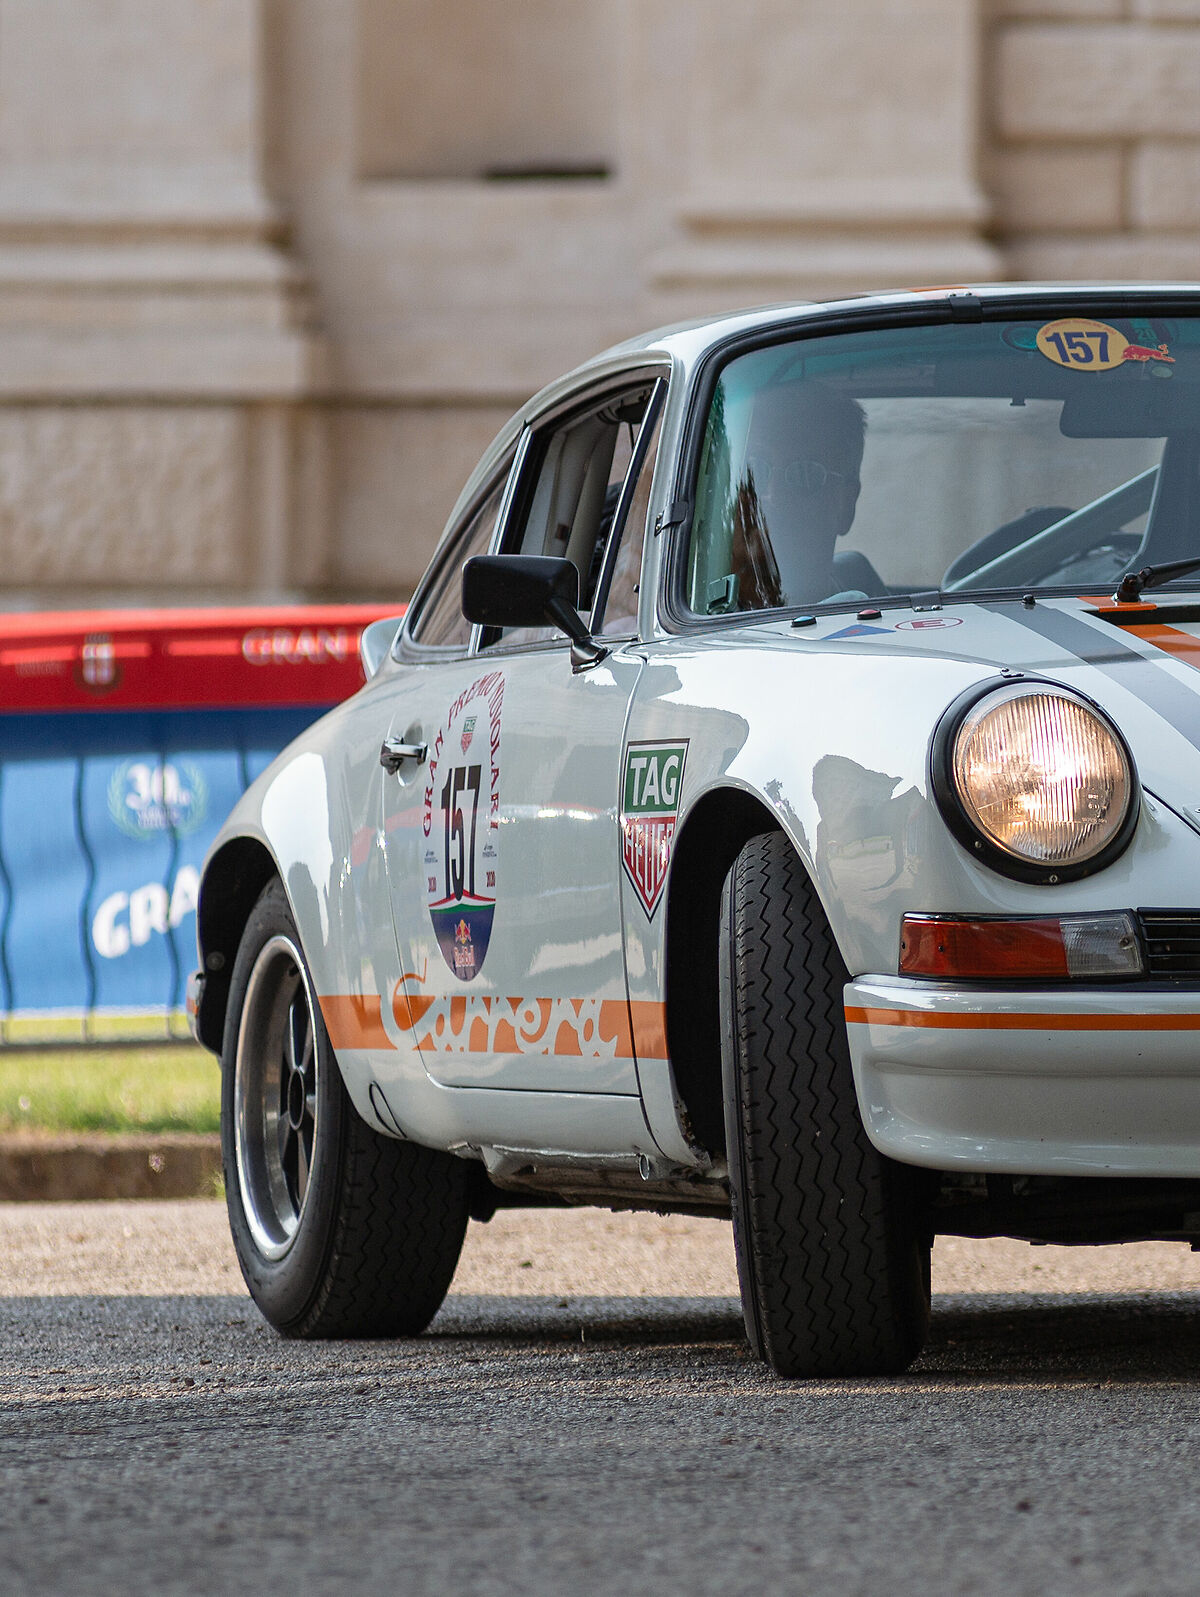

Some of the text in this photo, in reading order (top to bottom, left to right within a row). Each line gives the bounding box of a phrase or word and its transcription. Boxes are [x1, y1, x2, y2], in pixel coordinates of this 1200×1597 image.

[1045, 332, 1110, 363] 157
[242, 628, 350, 666] GRAN
[423, 728, 444, 837] GRAN
[630, 754, 680, 807] TAG
[440, 764, 482, 902] 157
[625, 823, 675, 902] HEUER
[380, 957, 619, 1058] Carrera
